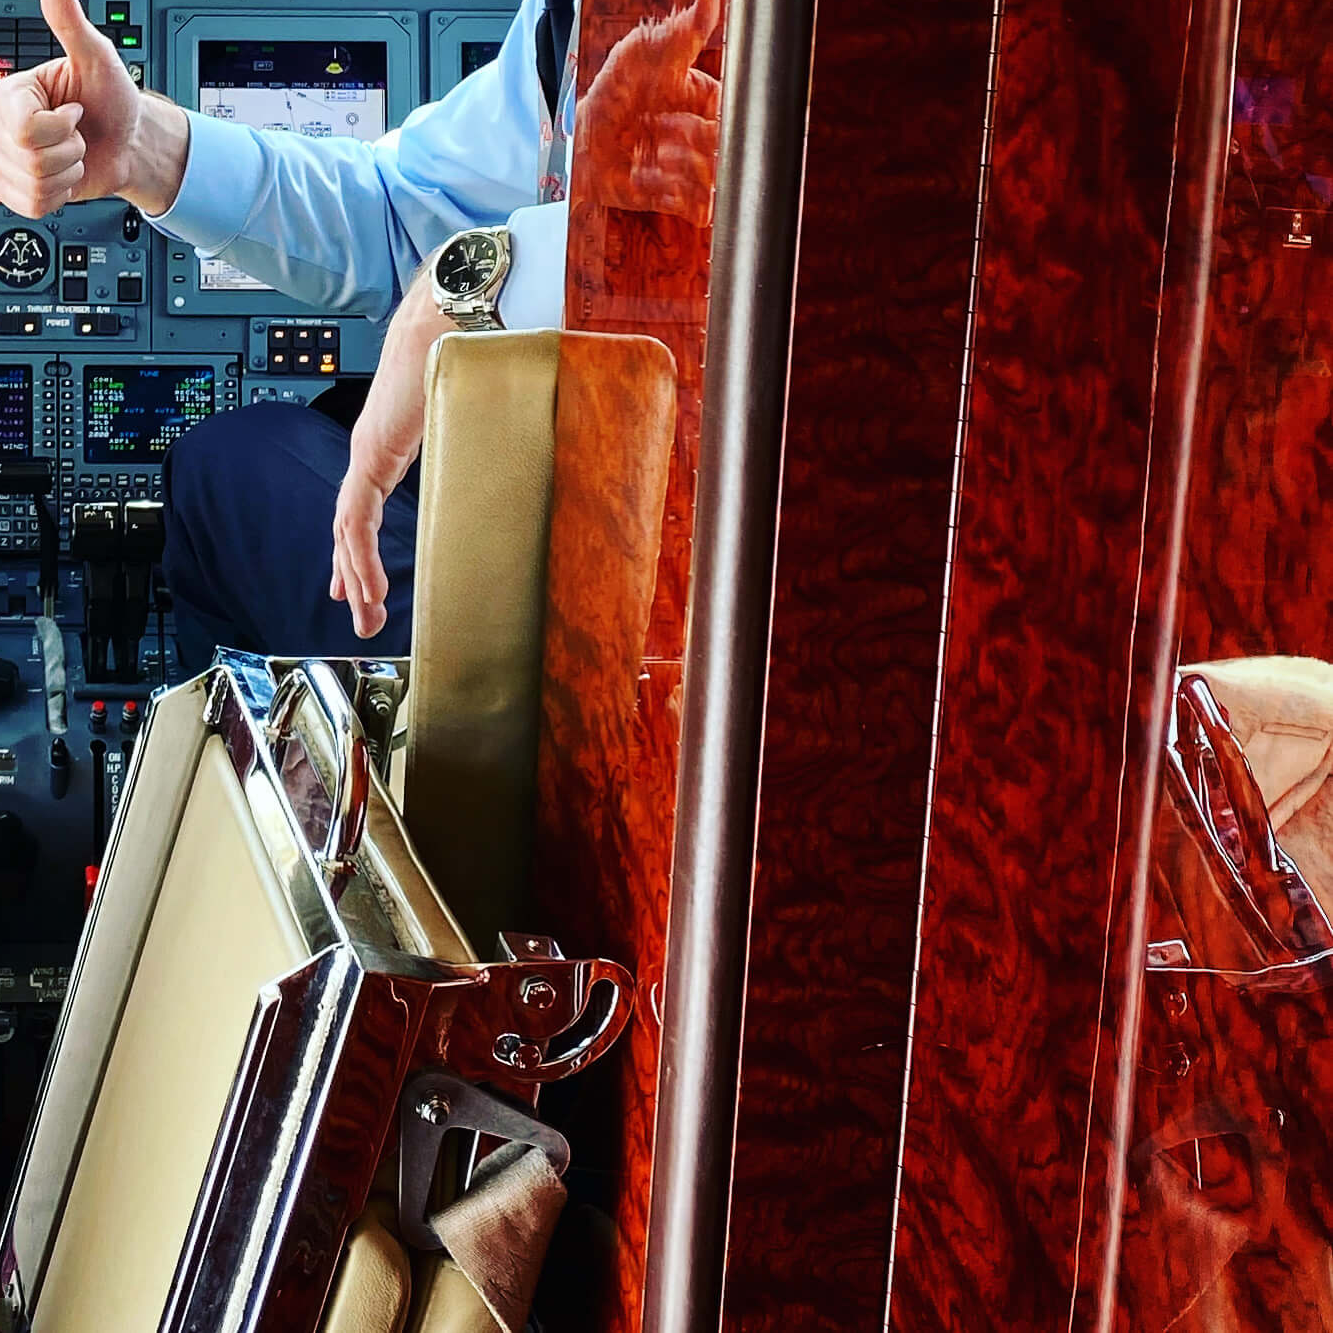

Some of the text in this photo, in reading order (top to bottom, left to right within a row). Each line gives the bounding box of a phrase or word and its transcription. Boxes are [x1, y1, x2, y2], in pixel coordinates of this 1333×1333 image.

[27, 306, 52, 314] THRUST
[56, 306, 90, 314] REVERSER
[46, 319, 70, 327] POWER
[108, 752, 122, 762] ON
[34, 990, 68, 998] TRANS
